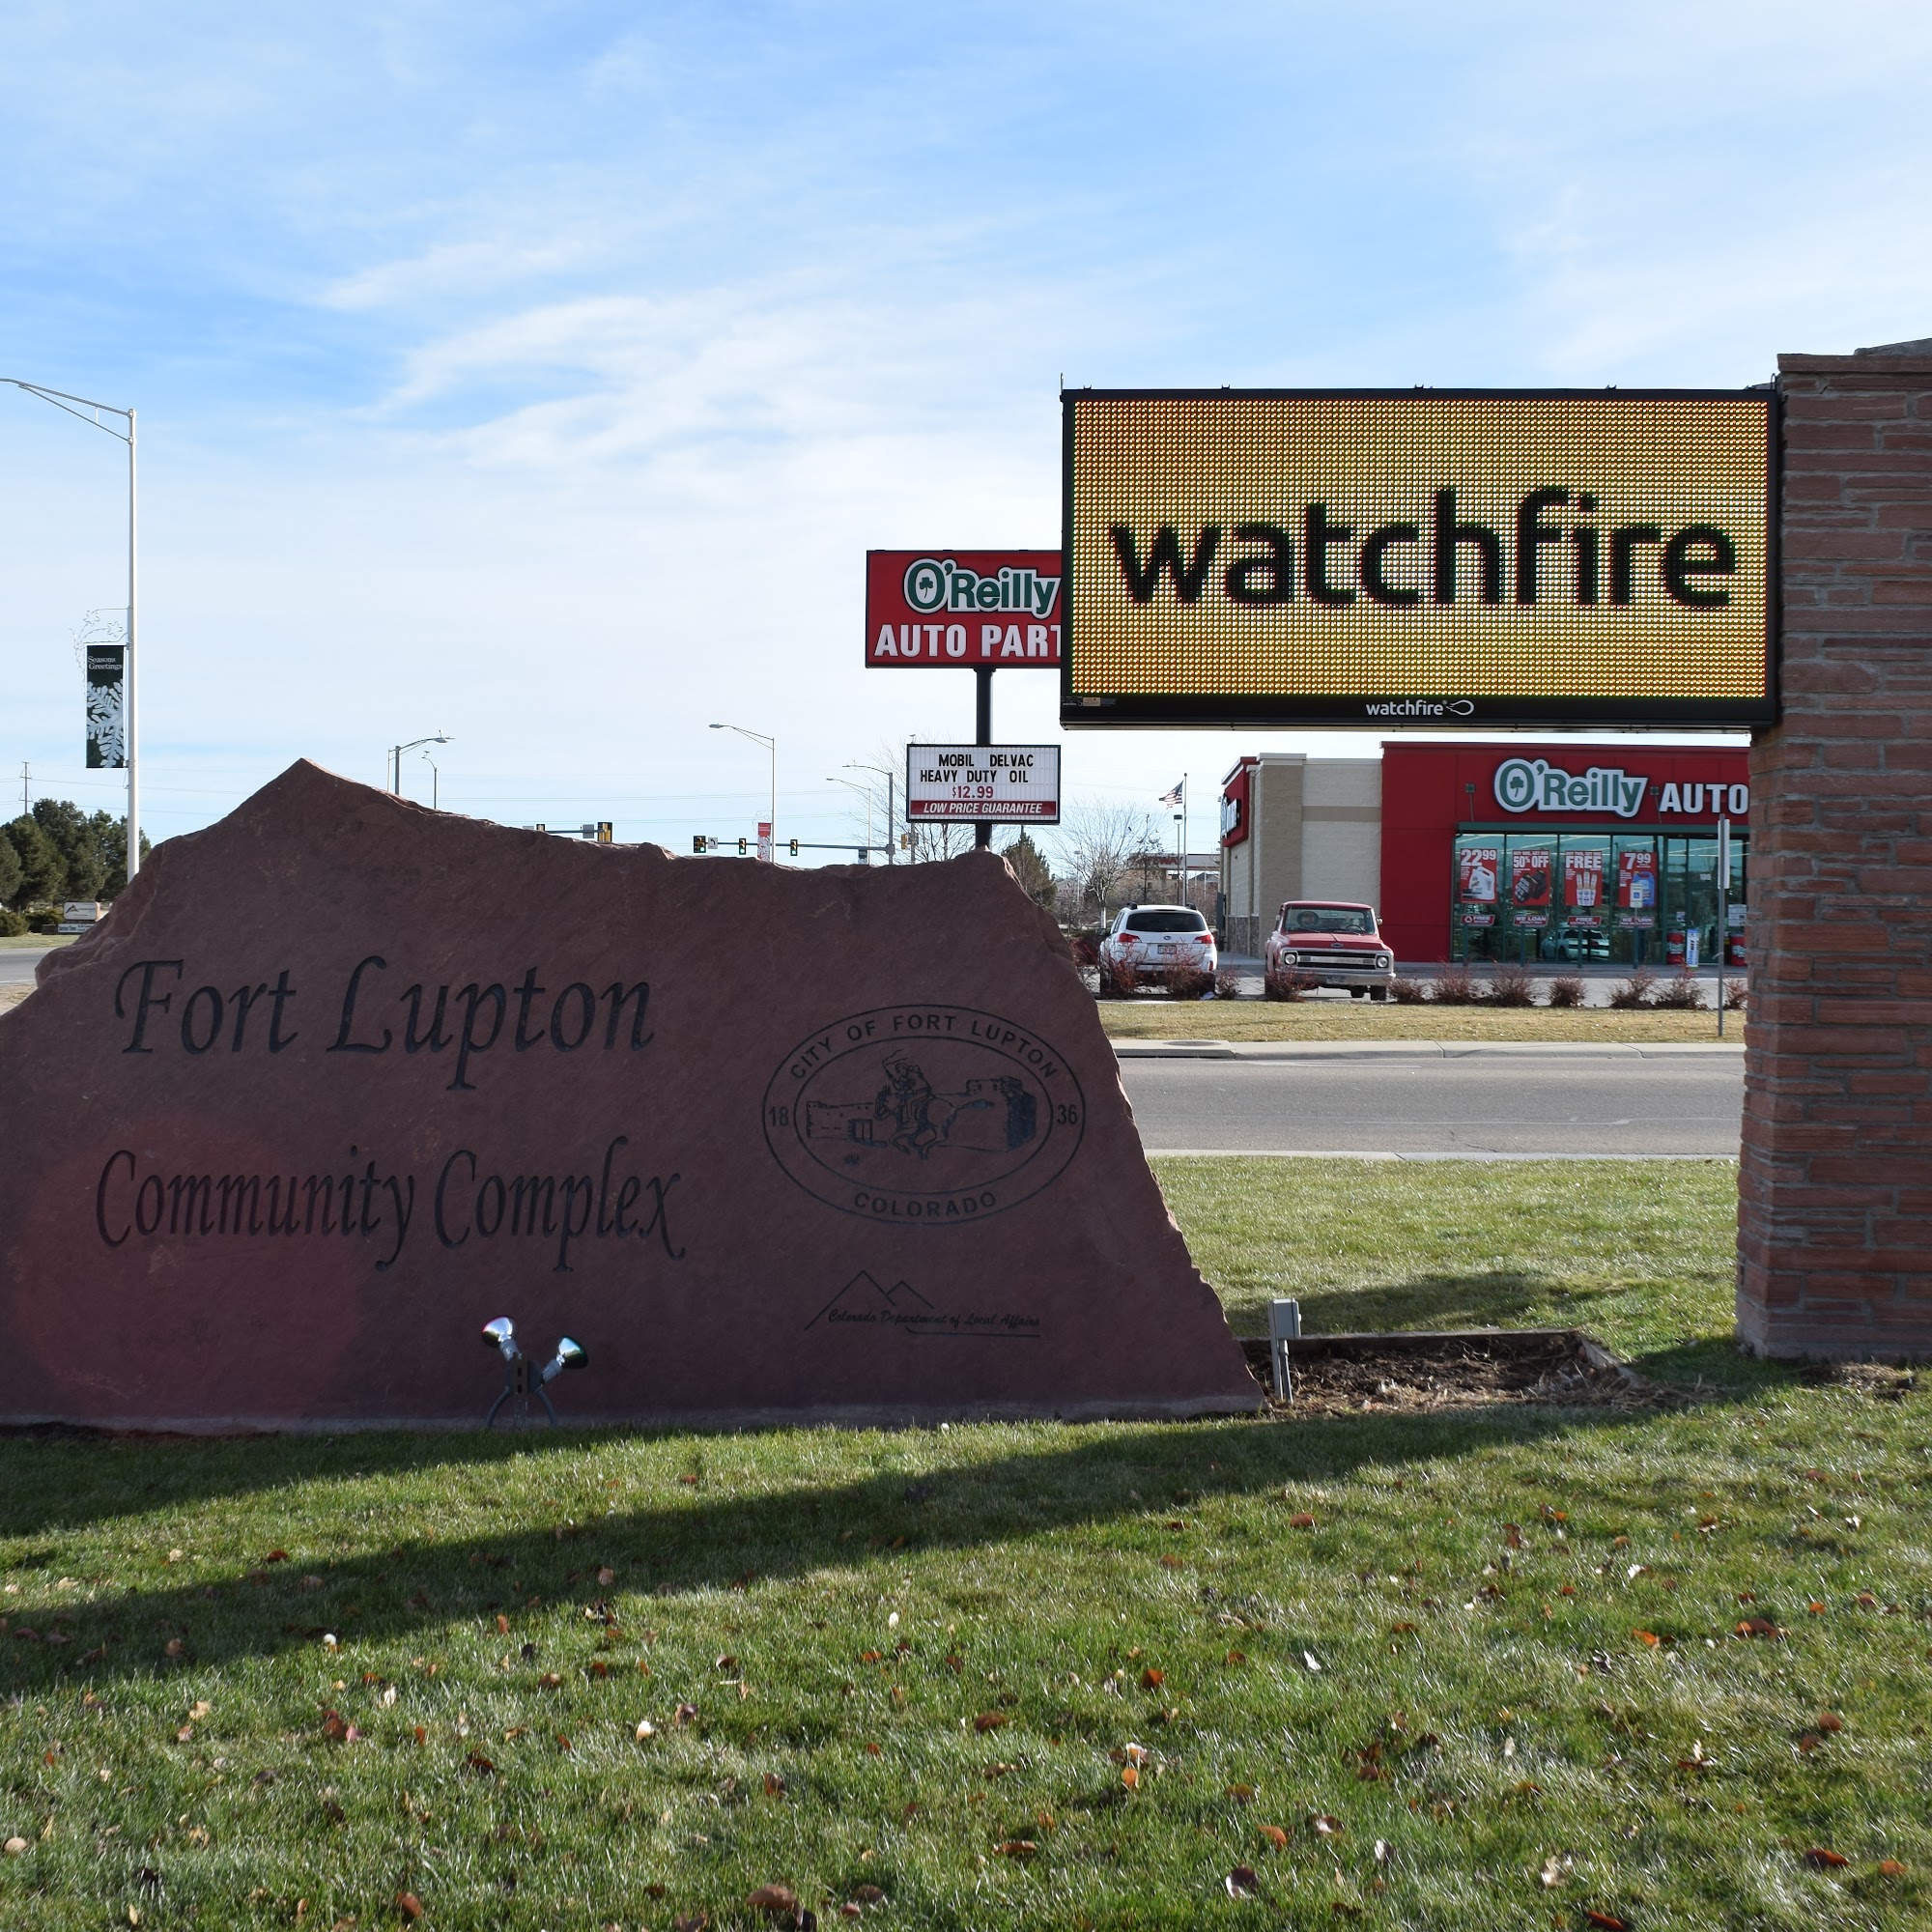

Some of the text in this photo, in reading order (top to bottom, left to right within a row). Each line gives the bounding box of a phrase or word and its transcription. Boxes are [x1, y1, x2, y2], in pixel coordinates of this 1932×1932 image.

[1108, 484, 1737, 608] watchfire
[906, 561, 1057, 615] O'Reilly
[874, 624, 967, 658] AUTO
[88, 655, 116, 664] Seasons
[1365, 699, 1444, 716] watchfire
[938, 753, 1035, 767] MOBIL DELVAC
[920, 769, 1029, 783] HEAVY DUTY OIL
[952, 785, 994, 799] $12.99
[1497, 761, 1644, 814] O'Reilly
[1659, 782, 1749, 814] AUTO
[923, 803, 1043, 814] LOW PRICE GUARANTEE
[1531, 856, 1549, 868] OFF
[1565, 855, 1602, 869] FREE
[114, 955, 654, 1091] Fort Lupton
[790, 1013, 1058, 1080] CITY OF FORT LUPTON
[769, 1106, 789, 1127] 18
[1057, 1104, 1078, 1125] 36
[97, 1136, 687, 1272] Community Complex
[854, 1192, 997, 1218] COLORADO
[828, 1309, 1039, 1329] Colorado Department of Local Affairs
